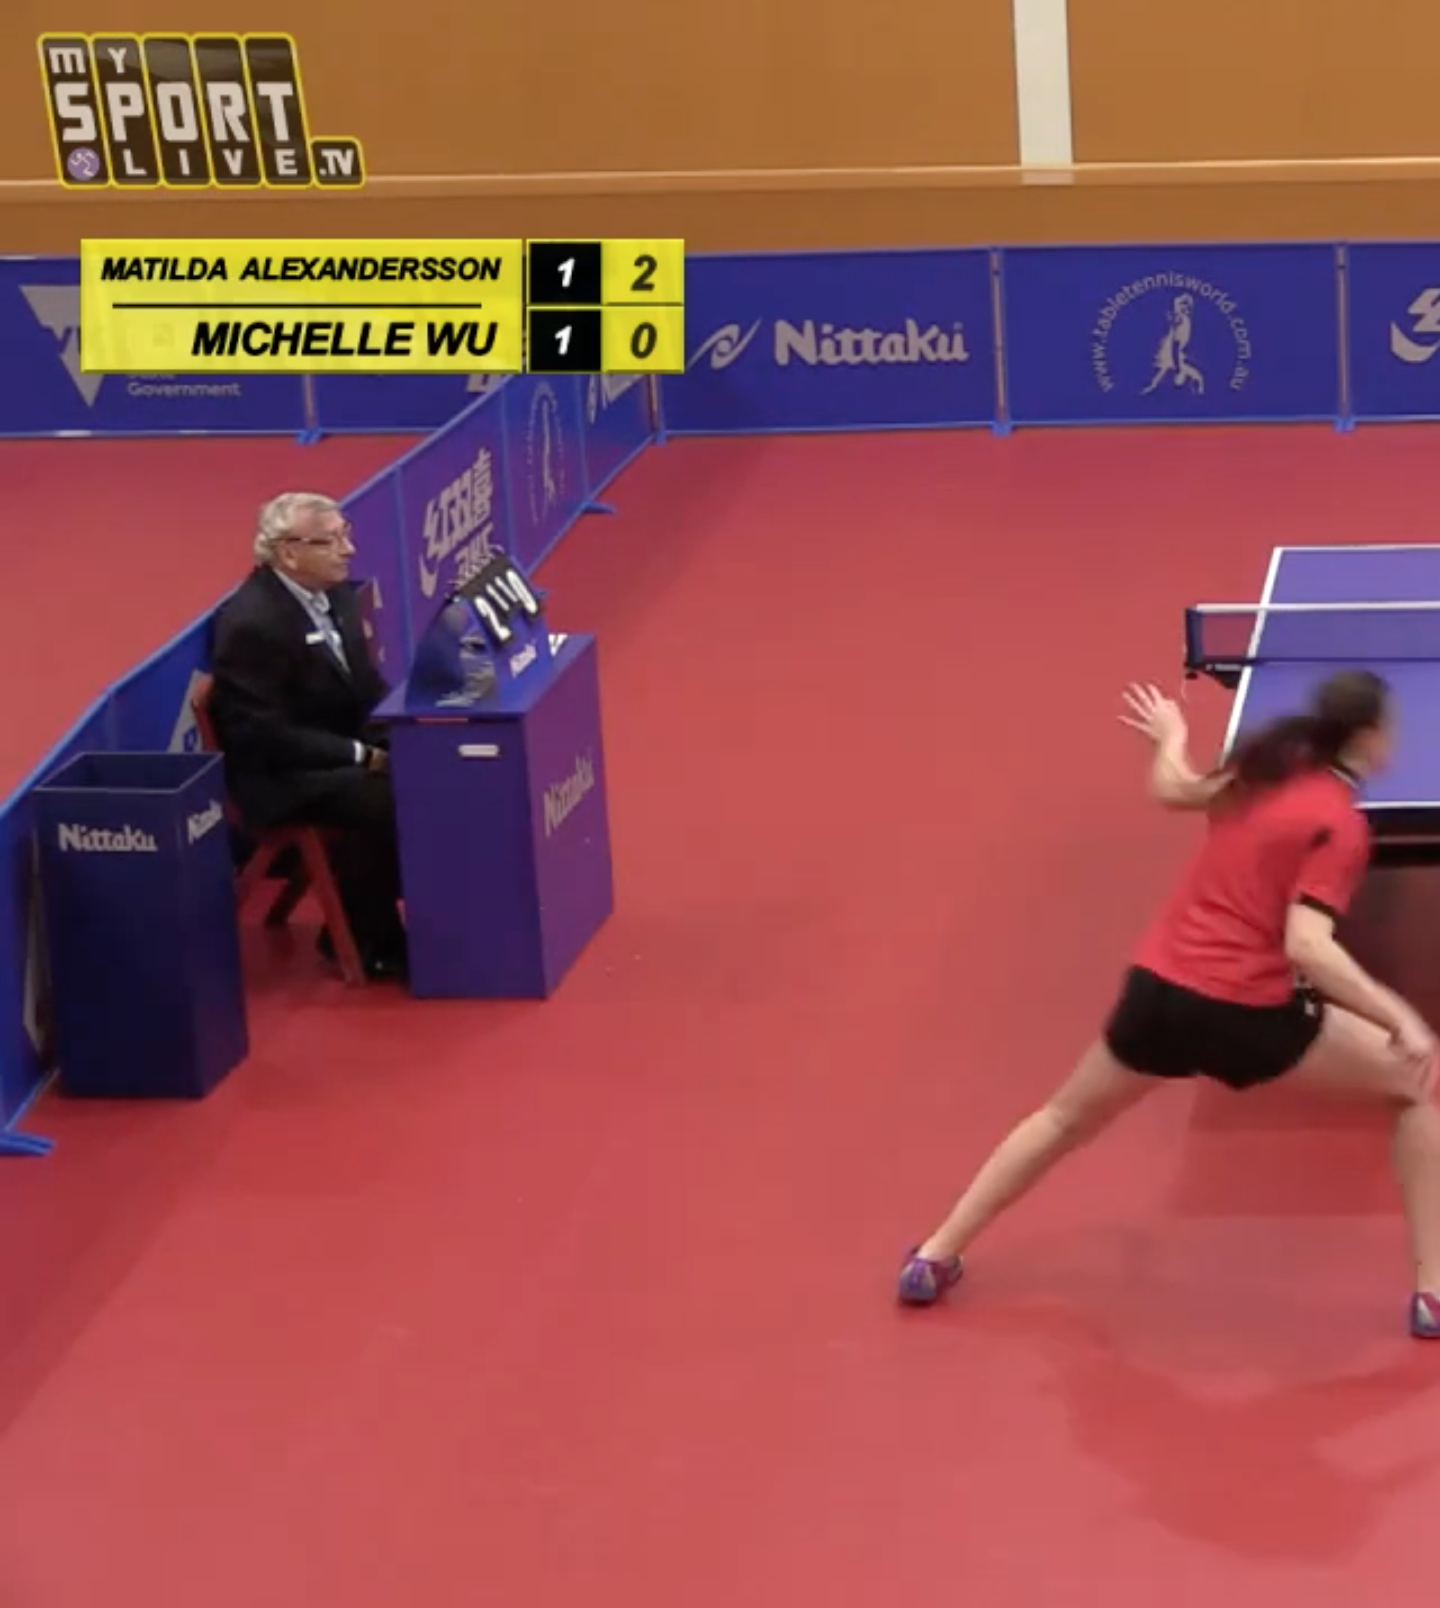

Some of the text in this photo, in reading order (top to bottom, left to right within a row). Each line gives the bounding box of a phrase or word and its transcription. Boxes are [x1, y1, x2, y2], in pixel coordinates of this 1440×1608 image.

[774, 318, 969, 366] Nittaku
[127, 381, 241, 398] Government
[474, 596, 512, 641] 2
[58, 822, 158, 852] Nittaku
